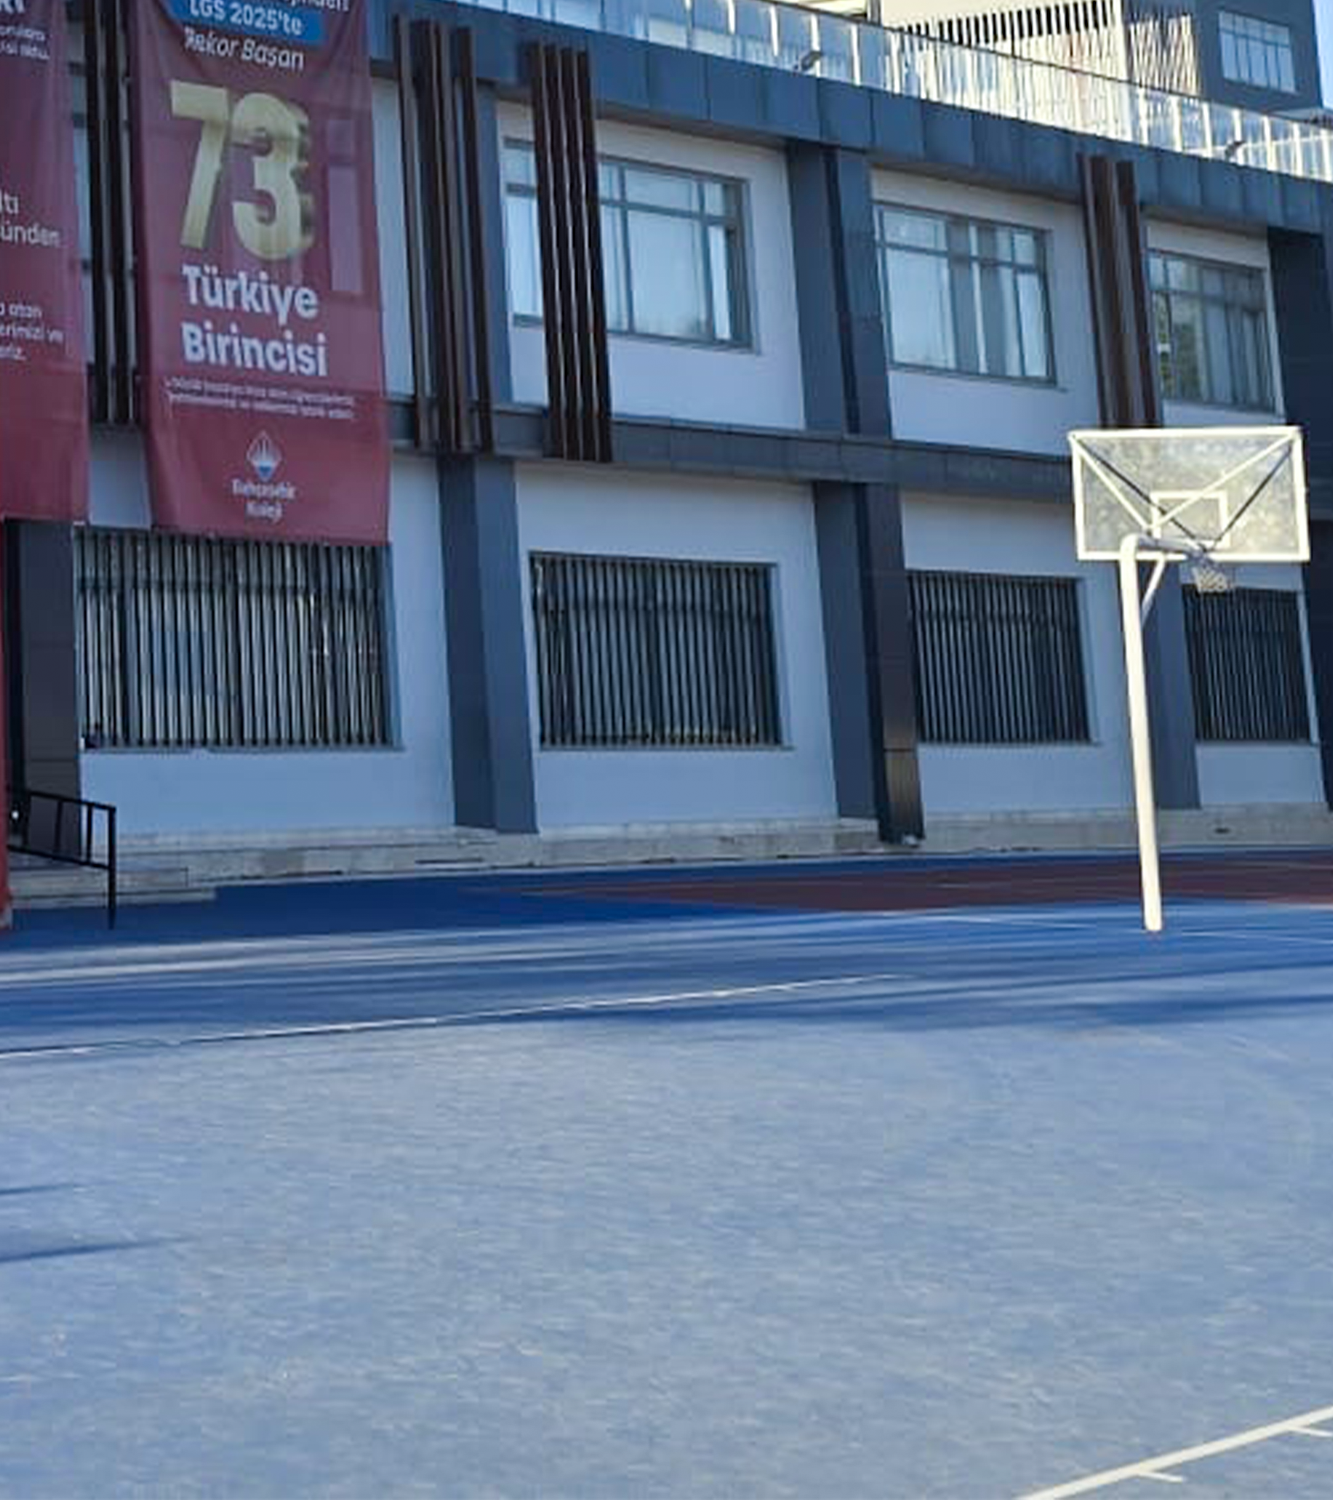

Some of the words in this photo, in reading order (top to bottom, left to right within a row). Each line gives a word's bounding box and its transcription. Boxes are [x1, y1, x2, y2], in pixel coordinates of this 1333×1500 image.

[229, 1, 303, 36] 2025'te
[170, 79, 315, 262] 73
[182, 263, 320, 326] Türkiye
[181, 318, 329, 378] Birincisi
